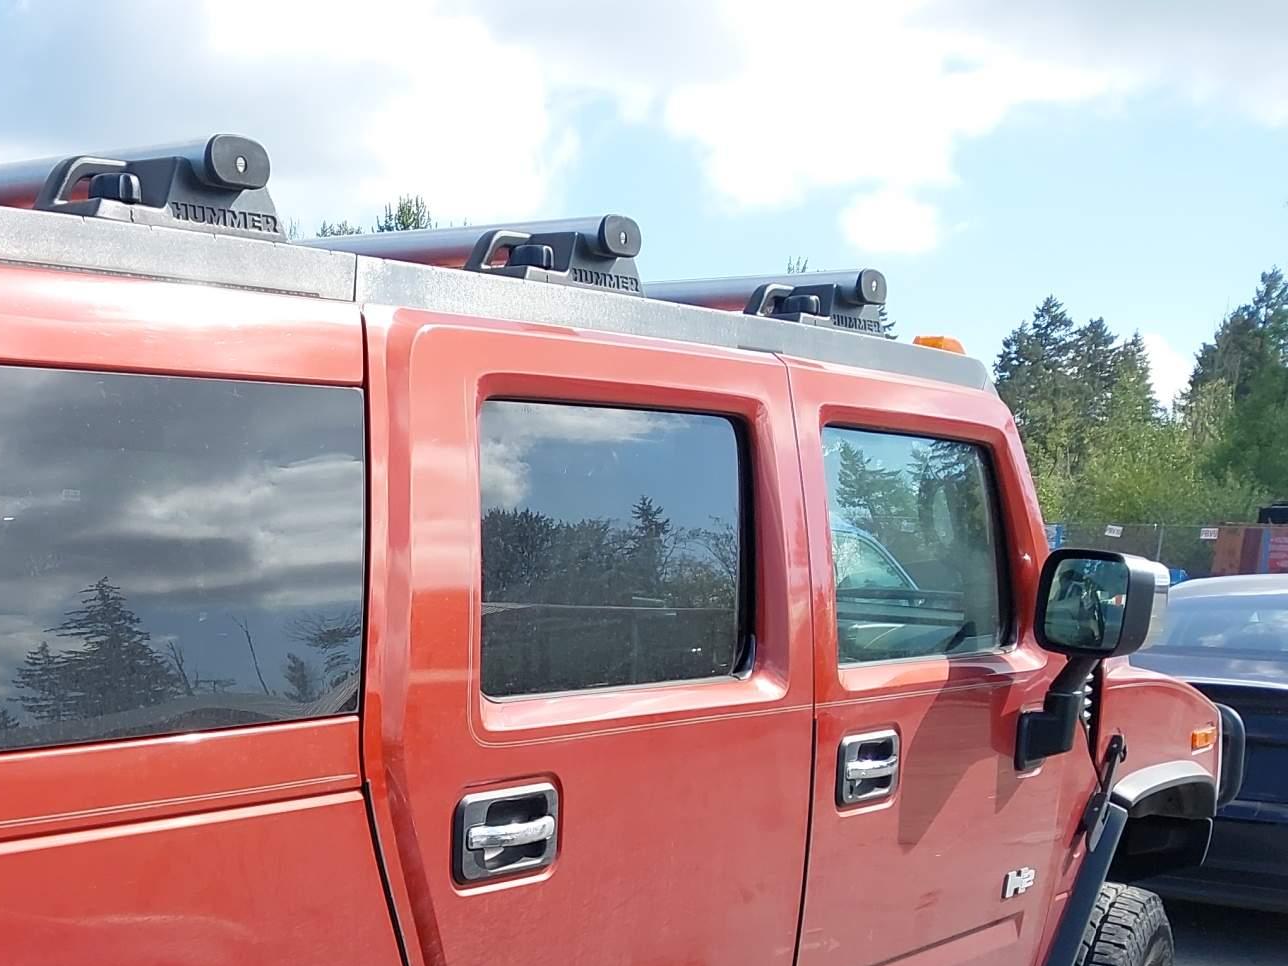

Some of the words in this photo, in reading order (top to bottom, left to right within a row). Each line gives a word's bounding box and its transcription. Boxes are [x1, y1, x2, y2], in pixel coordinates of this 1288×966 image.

[171, 201, 279, 234] HUMMER
[571, 267, 640, 294] HUMMER
[1001, 867, 1036, 899] H2
